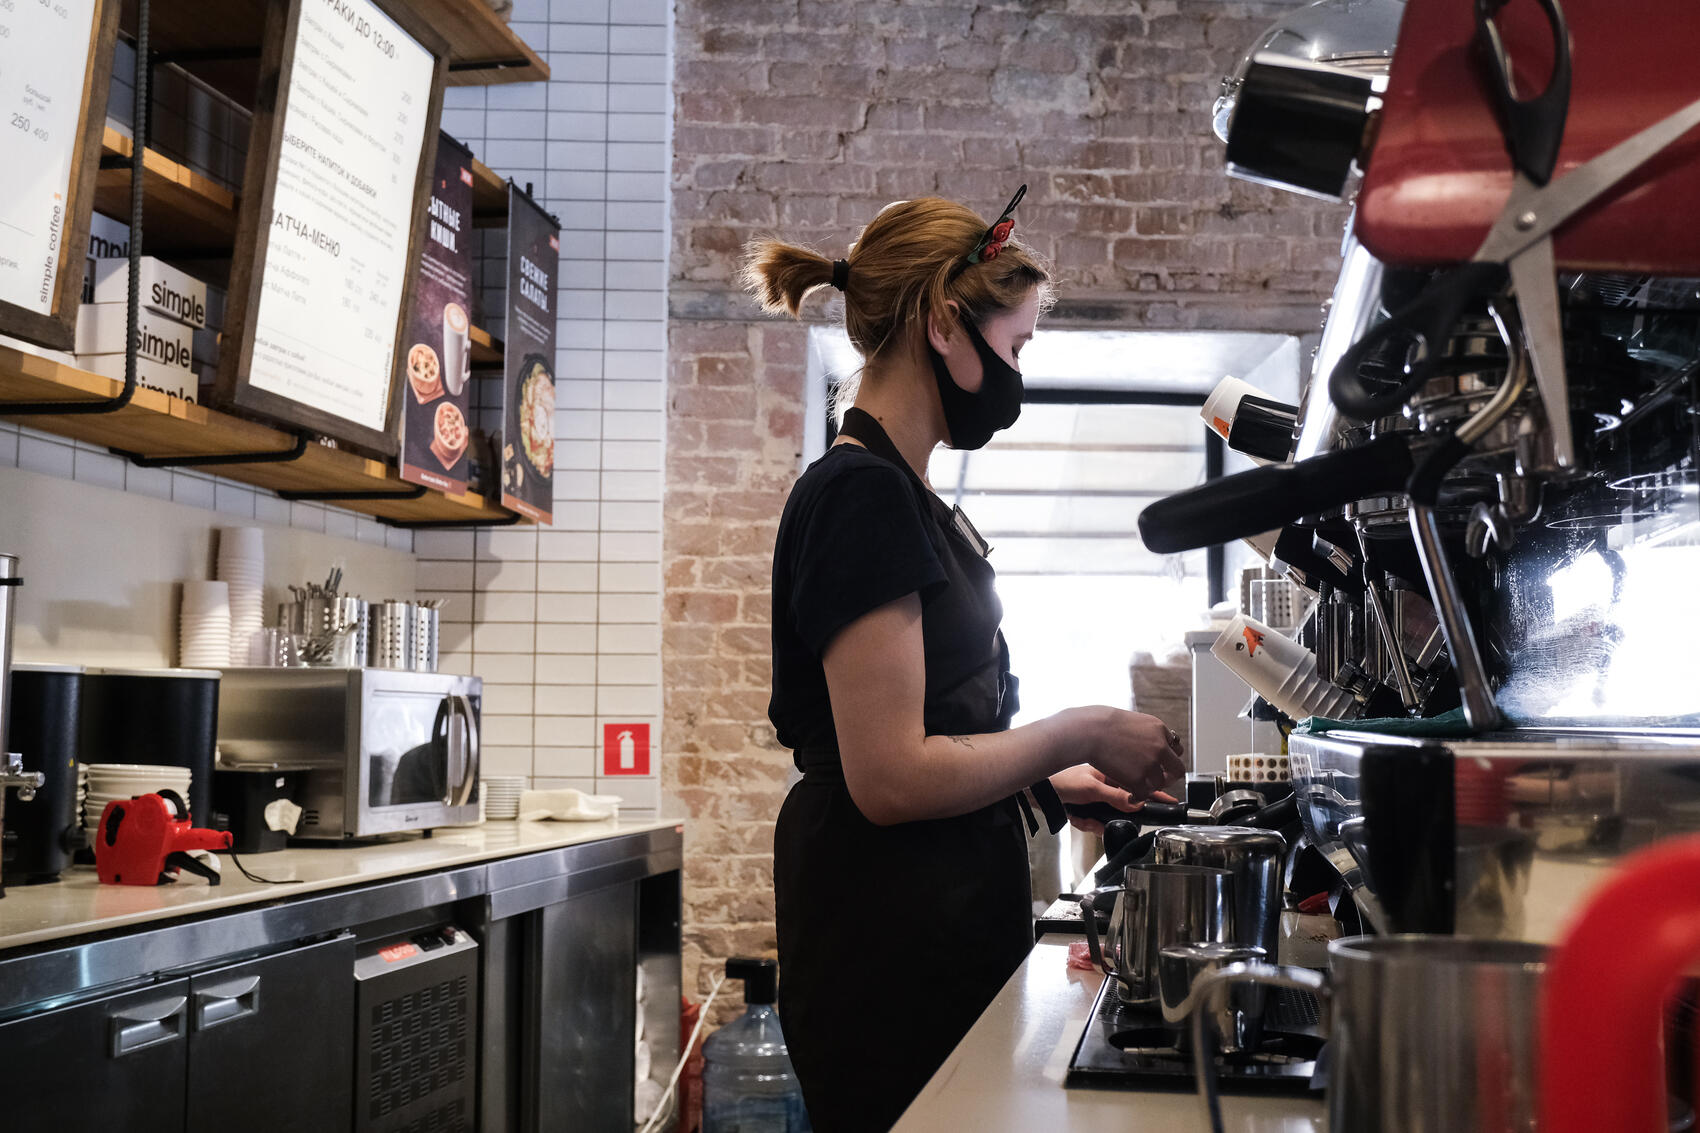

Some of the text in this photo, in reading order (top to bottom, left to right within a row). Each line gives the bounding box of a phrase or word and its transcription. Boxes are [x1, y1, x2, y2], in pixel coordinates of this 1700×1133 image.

[355, 16, 371, 38] ДО
[372, 30, 396, 59] 12:00
[10, 112, 49, 141] 250 400
[283, 132, 317, 159] ЫБЕРИТЕ
[40, 205, 61, 303] simple coffee
[270, 211, 342, 258] АТЧА-МЕНЮ
[152, 280, 204, 325] simple
